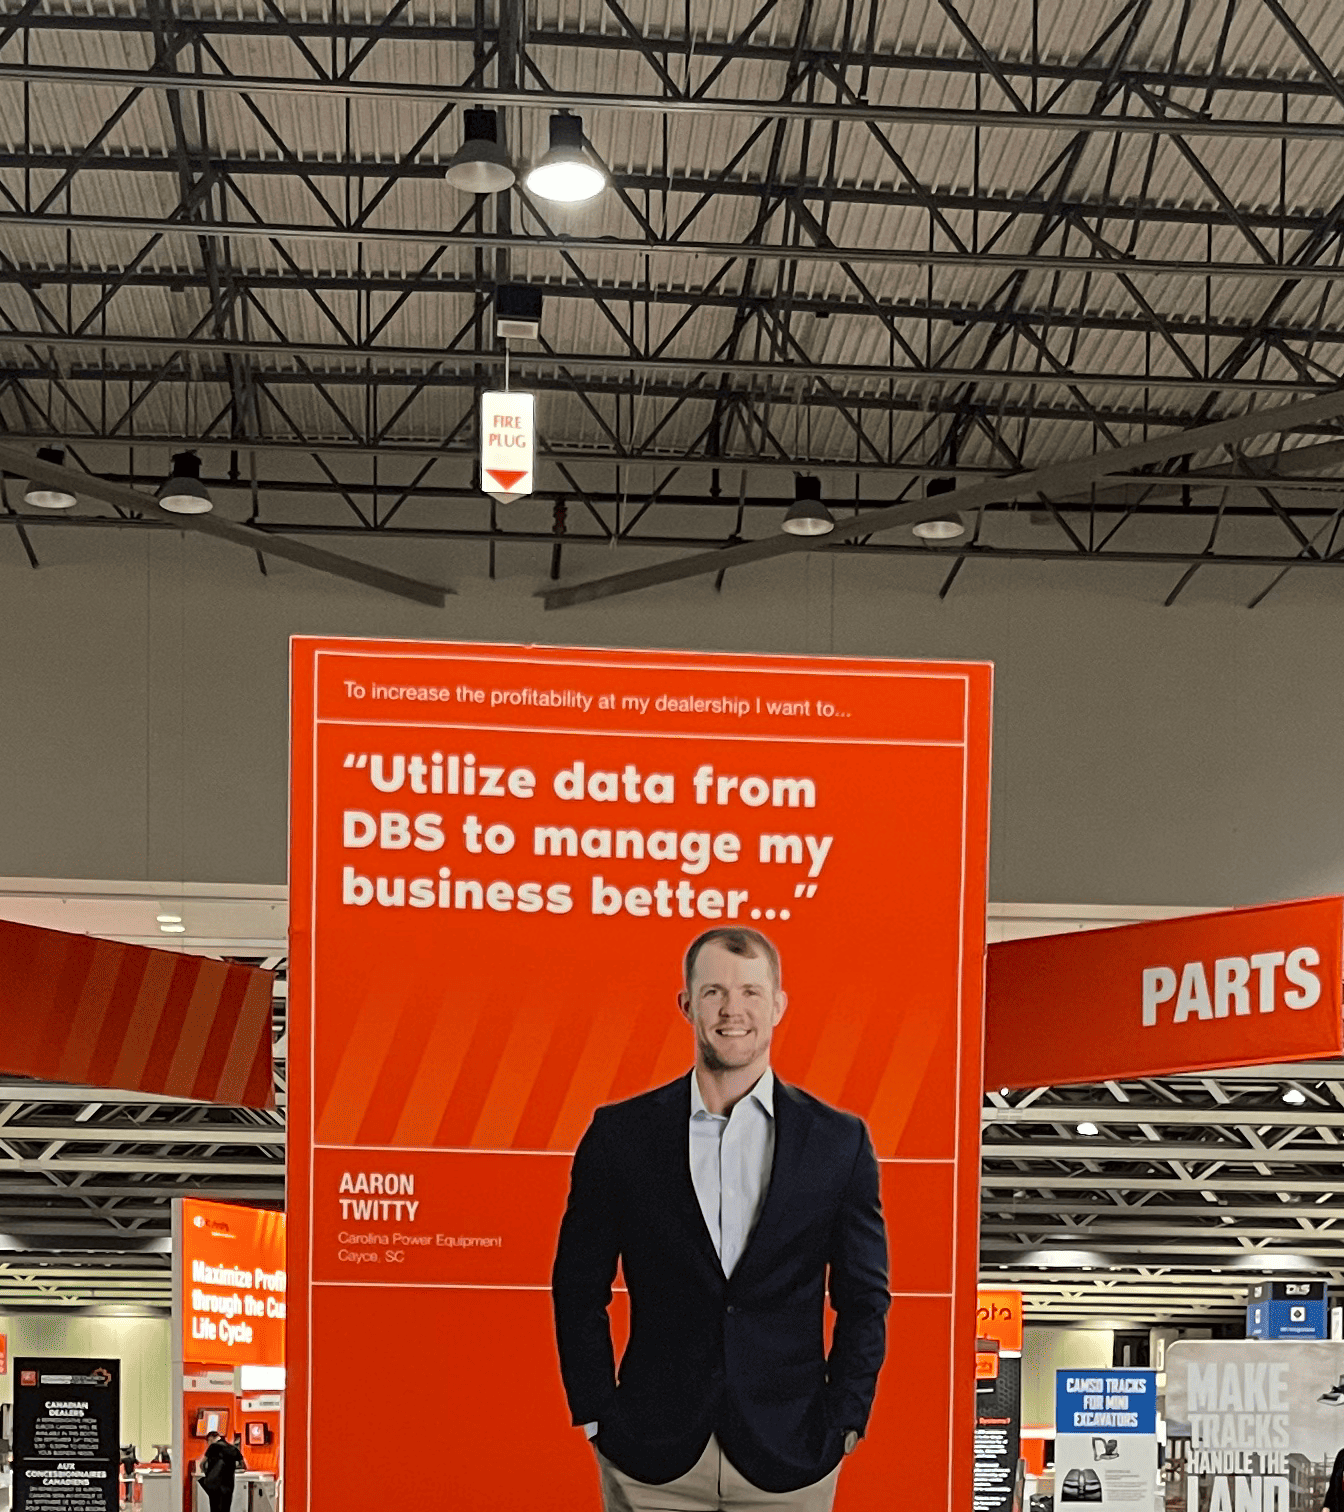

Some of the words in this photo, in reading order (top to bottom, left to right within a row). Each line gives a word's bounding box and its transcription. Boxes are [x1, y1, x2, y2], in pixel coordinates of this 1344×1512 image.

[494, 415, 522, 429] FIRE
[489, 434, 526, 448] PLUG
[344, 681, 365, 698] To
[372, 683, 450, 701] increase
[456, 686, 485, 703] the
[491, 688, 593, 712] profitability
[599, 694, 615, 709] at
[622, 697, 650, 714] my
[655, 694, 750, 717] dealership
[757, 698, 760, 713] I
[766, 700, 810, 716] want
[554, 762, 674, 803] data
[694, 765, 815, 807] from
[344, 811, 444, 851] DBS
[463, 816, 514, 854] to
[534, 827, 740, 874] manage
[760, 835, 833, 877] my
[343, 866, 572, 913] business
[1142, 946, 1321, 1027] PARTS
[339, 1172, 414, 1195] AARON
[339, 1199, 419, 1222] TWITTY
[338, 1232, 389, 1245] Carolina
[393, 1233, 432, 1245] Power
[436, 1234, 502, 1248] Equipment
[385, 1250, 404, 1262] SC
[192, 1259, 253, 1288] Maximize
[192, 1289, 241, 1318] through
[244, 1295, 264, 1317] the
[193, 1318, 216, 1339] Life
[219, 1319, 252, 1346] Cycle
[1106, 1379, 1147, 1394] TRACKS
[1186, 1362, 1290, 1412] MAKE
[45, 1401, 88, 1409] CANADIAN
[1083, 1395, 1103, 1410] FOR
[1106, 1396, 1129, 1410] MINI
[1073, 1412, 1138, 1427] EXCAVATORS
[1188, 1414, 1290, 1448] TRACKS
[1187, 1450, 1253, 1474] HANDLE
[1259, 1451, 1289, 1474] THE
